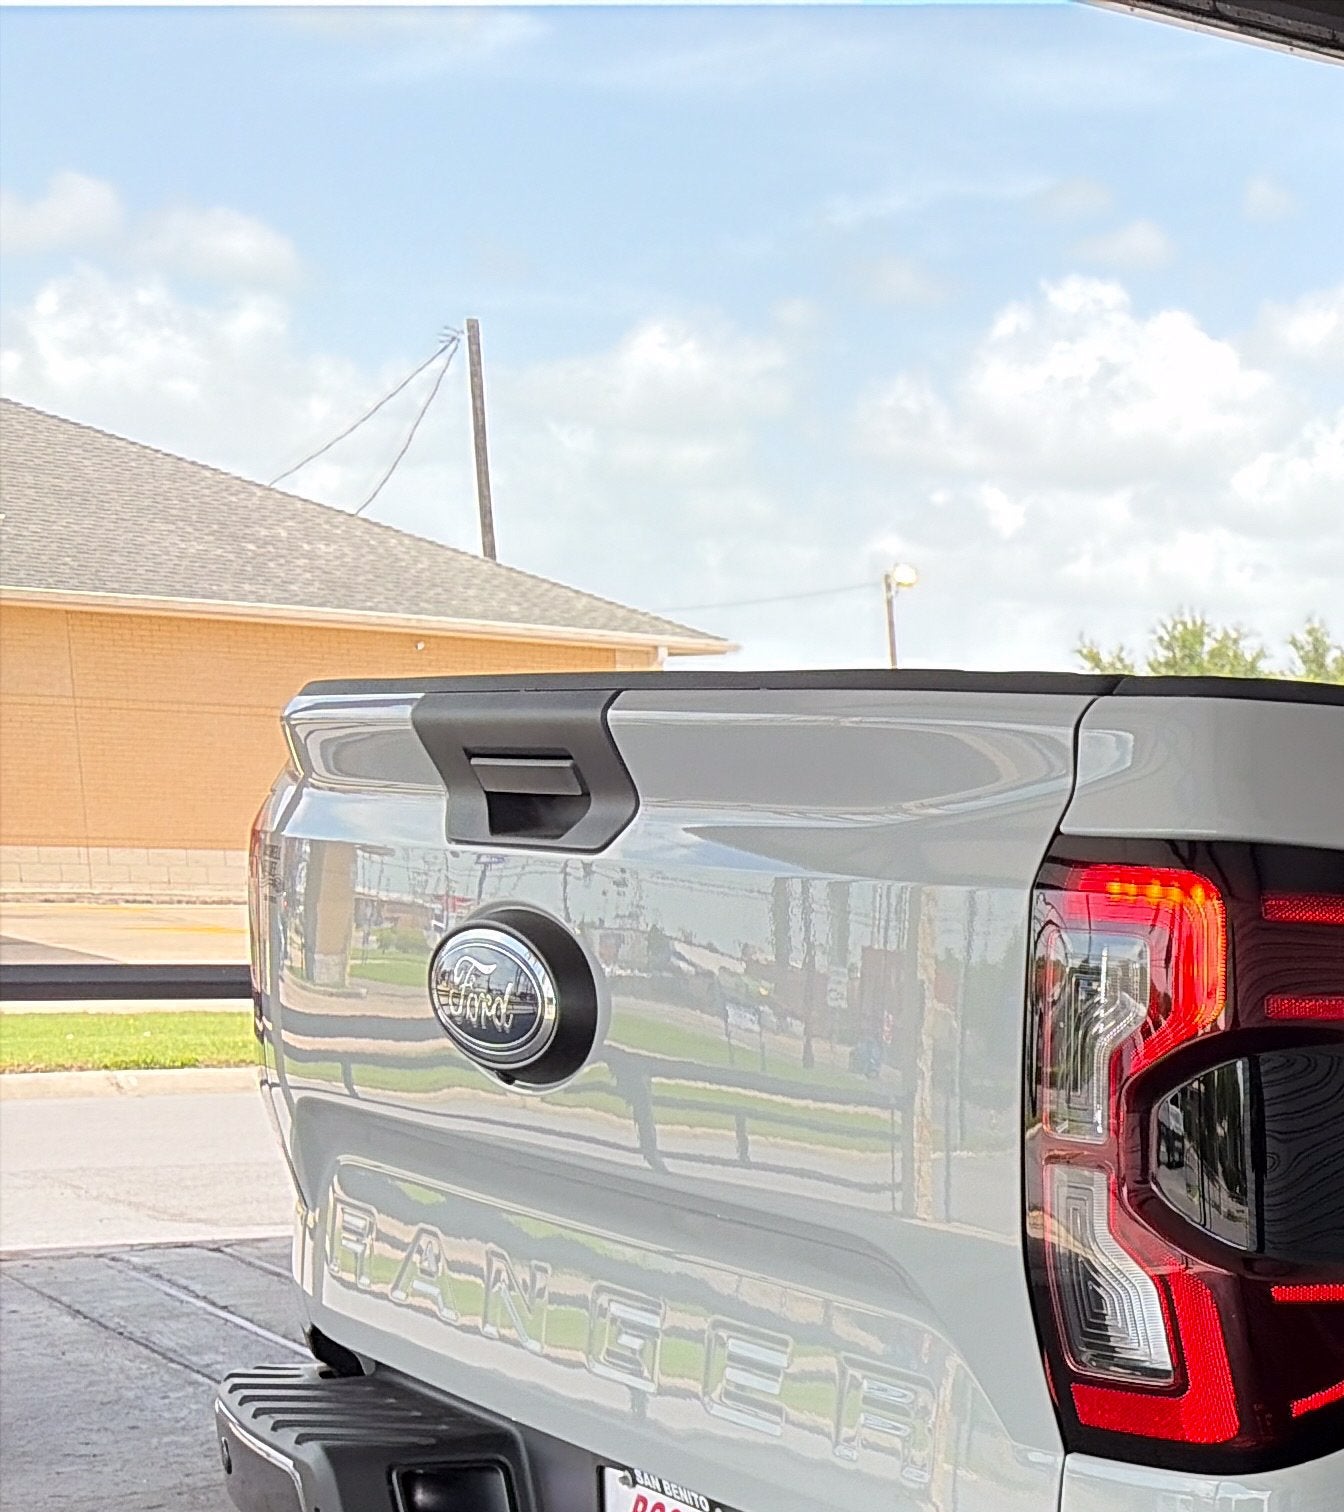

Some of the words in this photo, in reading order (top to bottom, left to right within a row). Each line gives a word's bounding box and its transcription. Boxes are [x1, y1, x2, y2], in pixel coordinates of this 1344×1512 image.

[448, 955, 515, 1031] Ford
[333, 1199, 936, 1486] RANGER
[634, 1468, 663, 1493] SAN
[664, 1482, 710, 1512] BENITO
